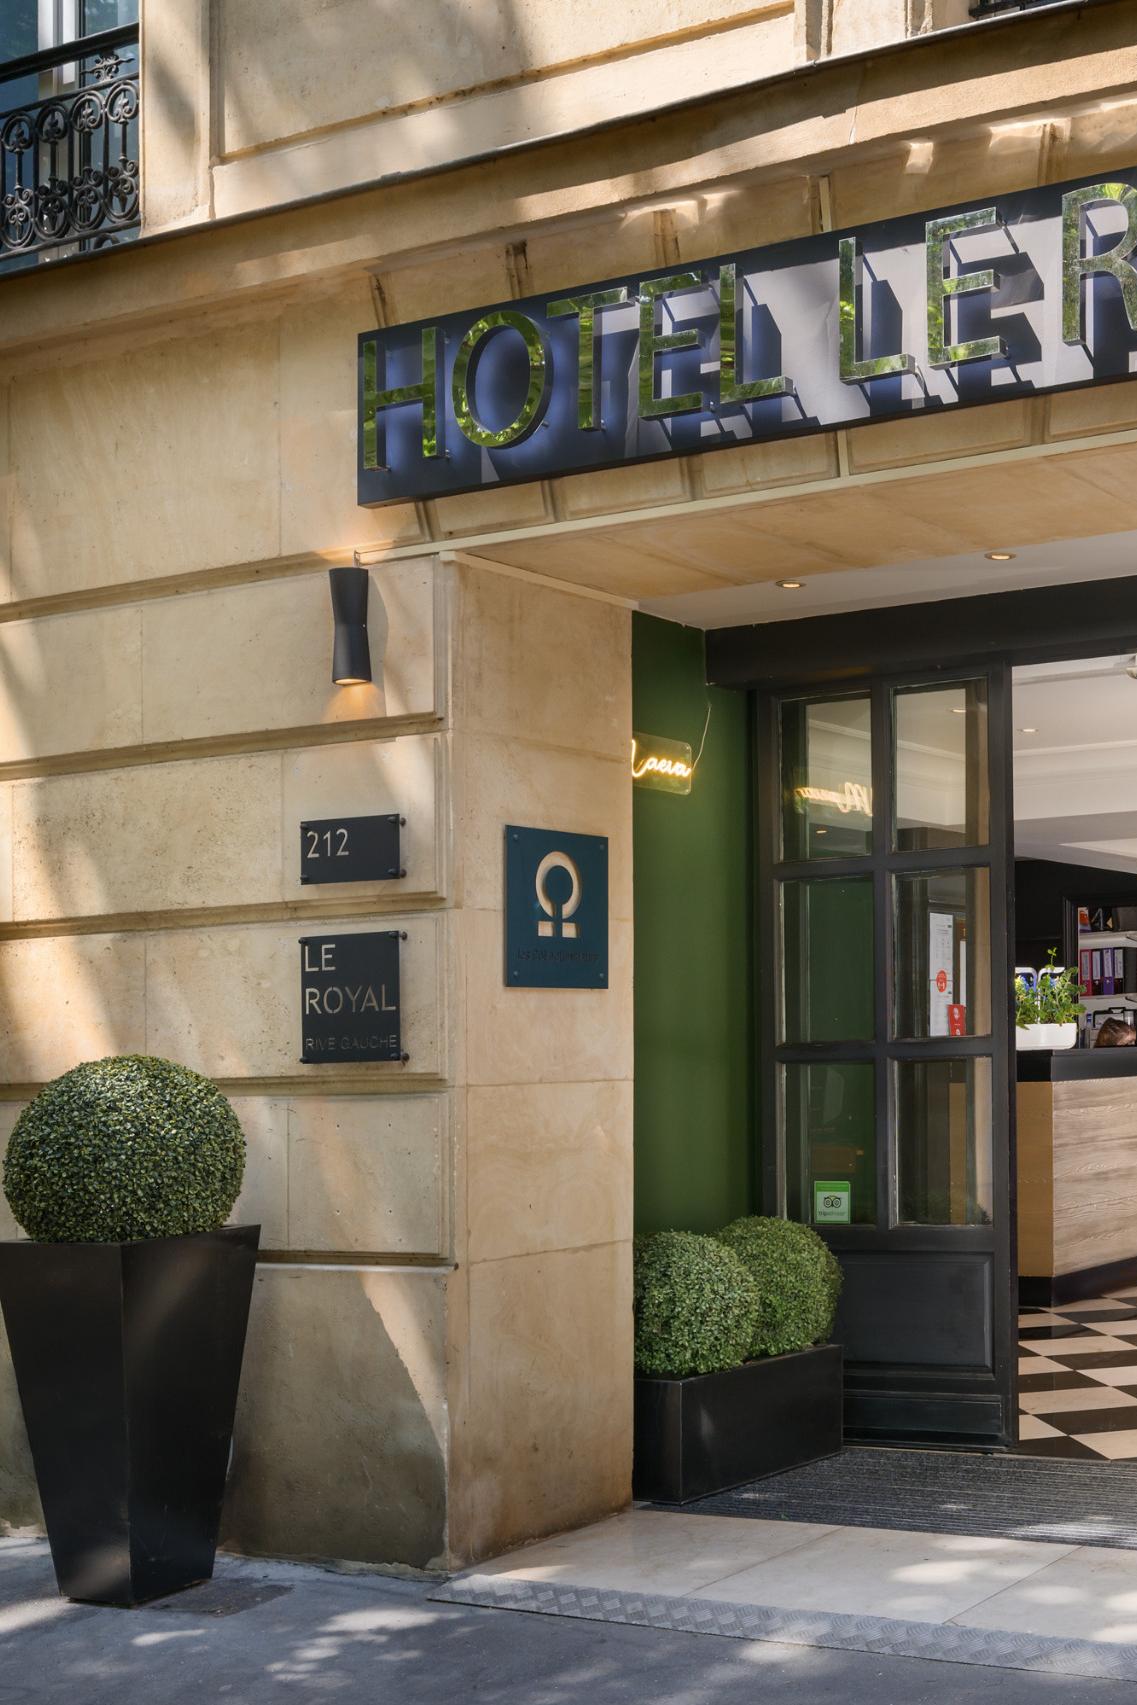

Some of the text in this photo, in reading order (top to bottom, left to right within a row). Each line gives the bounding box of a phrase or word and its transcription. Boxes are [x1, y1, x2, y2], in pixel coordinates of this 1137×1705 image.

[363, 263, 796, 472] HOTEL
[838, 206, 1009, 386] LE
[306, 829, 350, 858] 212
[304, 943, 336, 973] LE
[305, 984, 397, 1015] ROYAL
[305, 1034, 398, 1051] RIVE GAUCHE
